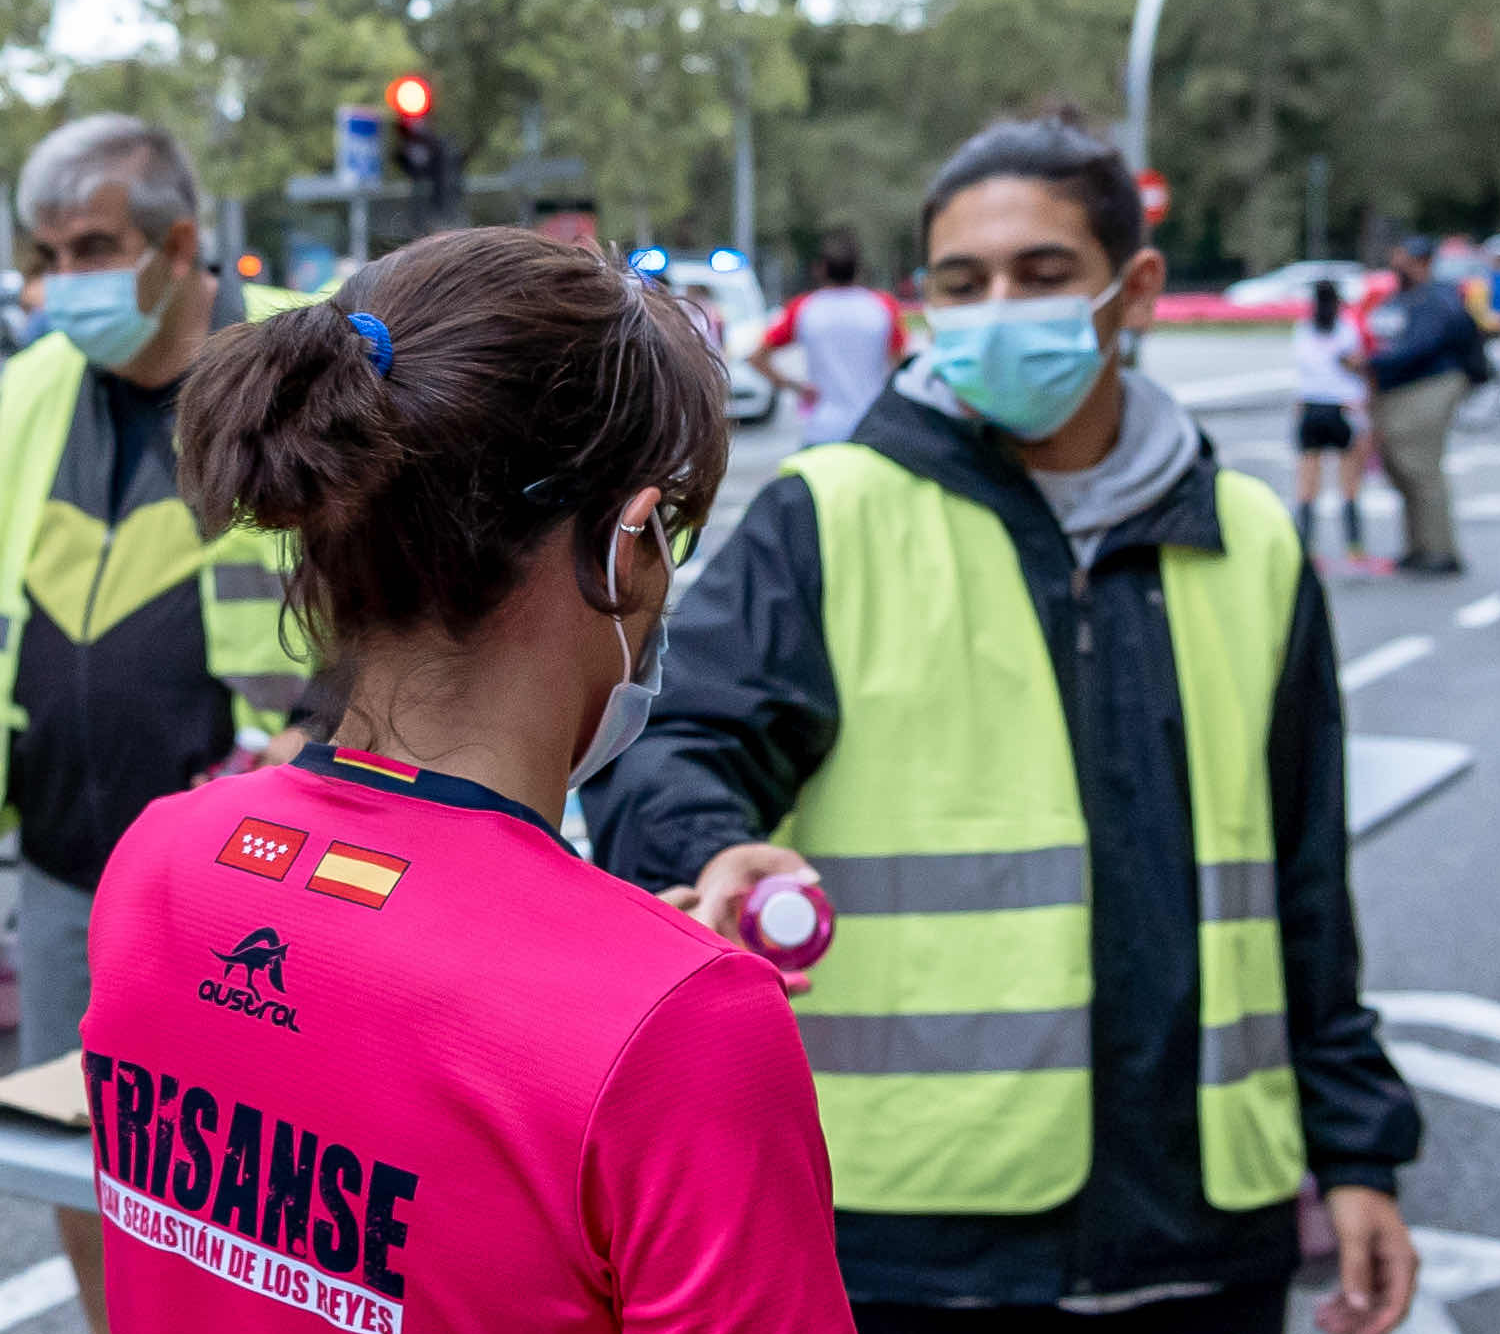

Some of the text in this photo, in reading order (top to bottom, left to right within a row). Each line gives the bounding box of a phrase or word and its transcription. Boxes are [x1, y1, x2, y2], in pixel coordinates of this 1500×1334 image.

[124, 1196, 225, 1269] SEBASTIÁN
[228, 1245, 256, 1285] DE
[262, 1259, 309, 1304] LOS
